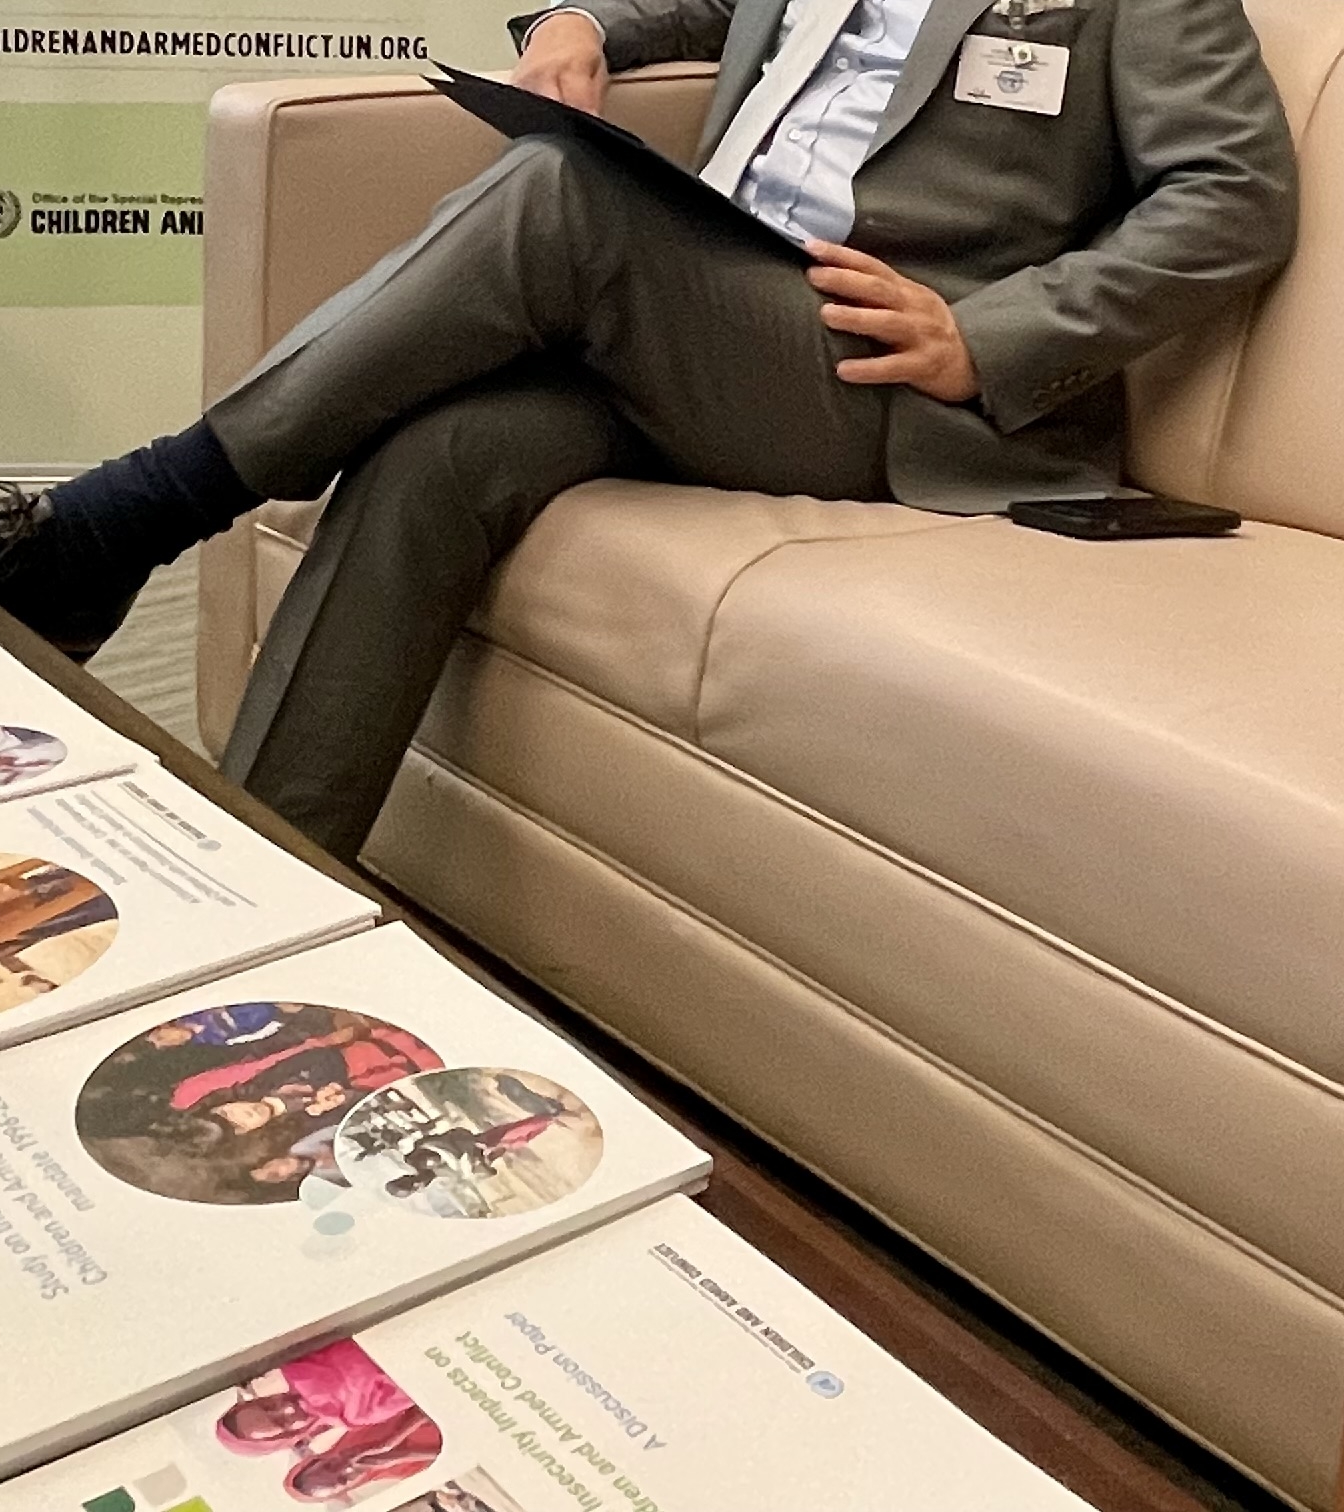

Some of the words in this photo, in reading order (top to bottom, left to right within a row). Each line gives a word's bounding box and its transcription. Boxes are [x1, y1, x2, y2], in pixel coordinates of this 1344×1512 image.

[31, 209, 150, 234] CHILDREN
[11, 1191, 54, 1222] and
[3, 1235, 32, 1254] on
[44, 1220, 109, 1286] Children
[20, 1254, 70, 1300] Study
[503, 1311, 559, 1356] Paper
[424, 1345, 452, 1368] on
[454, 1330, 523, 1392] Conflict
[446, 1366, 519, 1433] Impacts
[513, 1389, 584, 1443] Armed
[552, 1351, 649, 1439] Discussion
[570, 1441, 617, 1476] and
[642, 1433, 669, 1452] A
[511, 1430, 604, 1512] Insecurity
